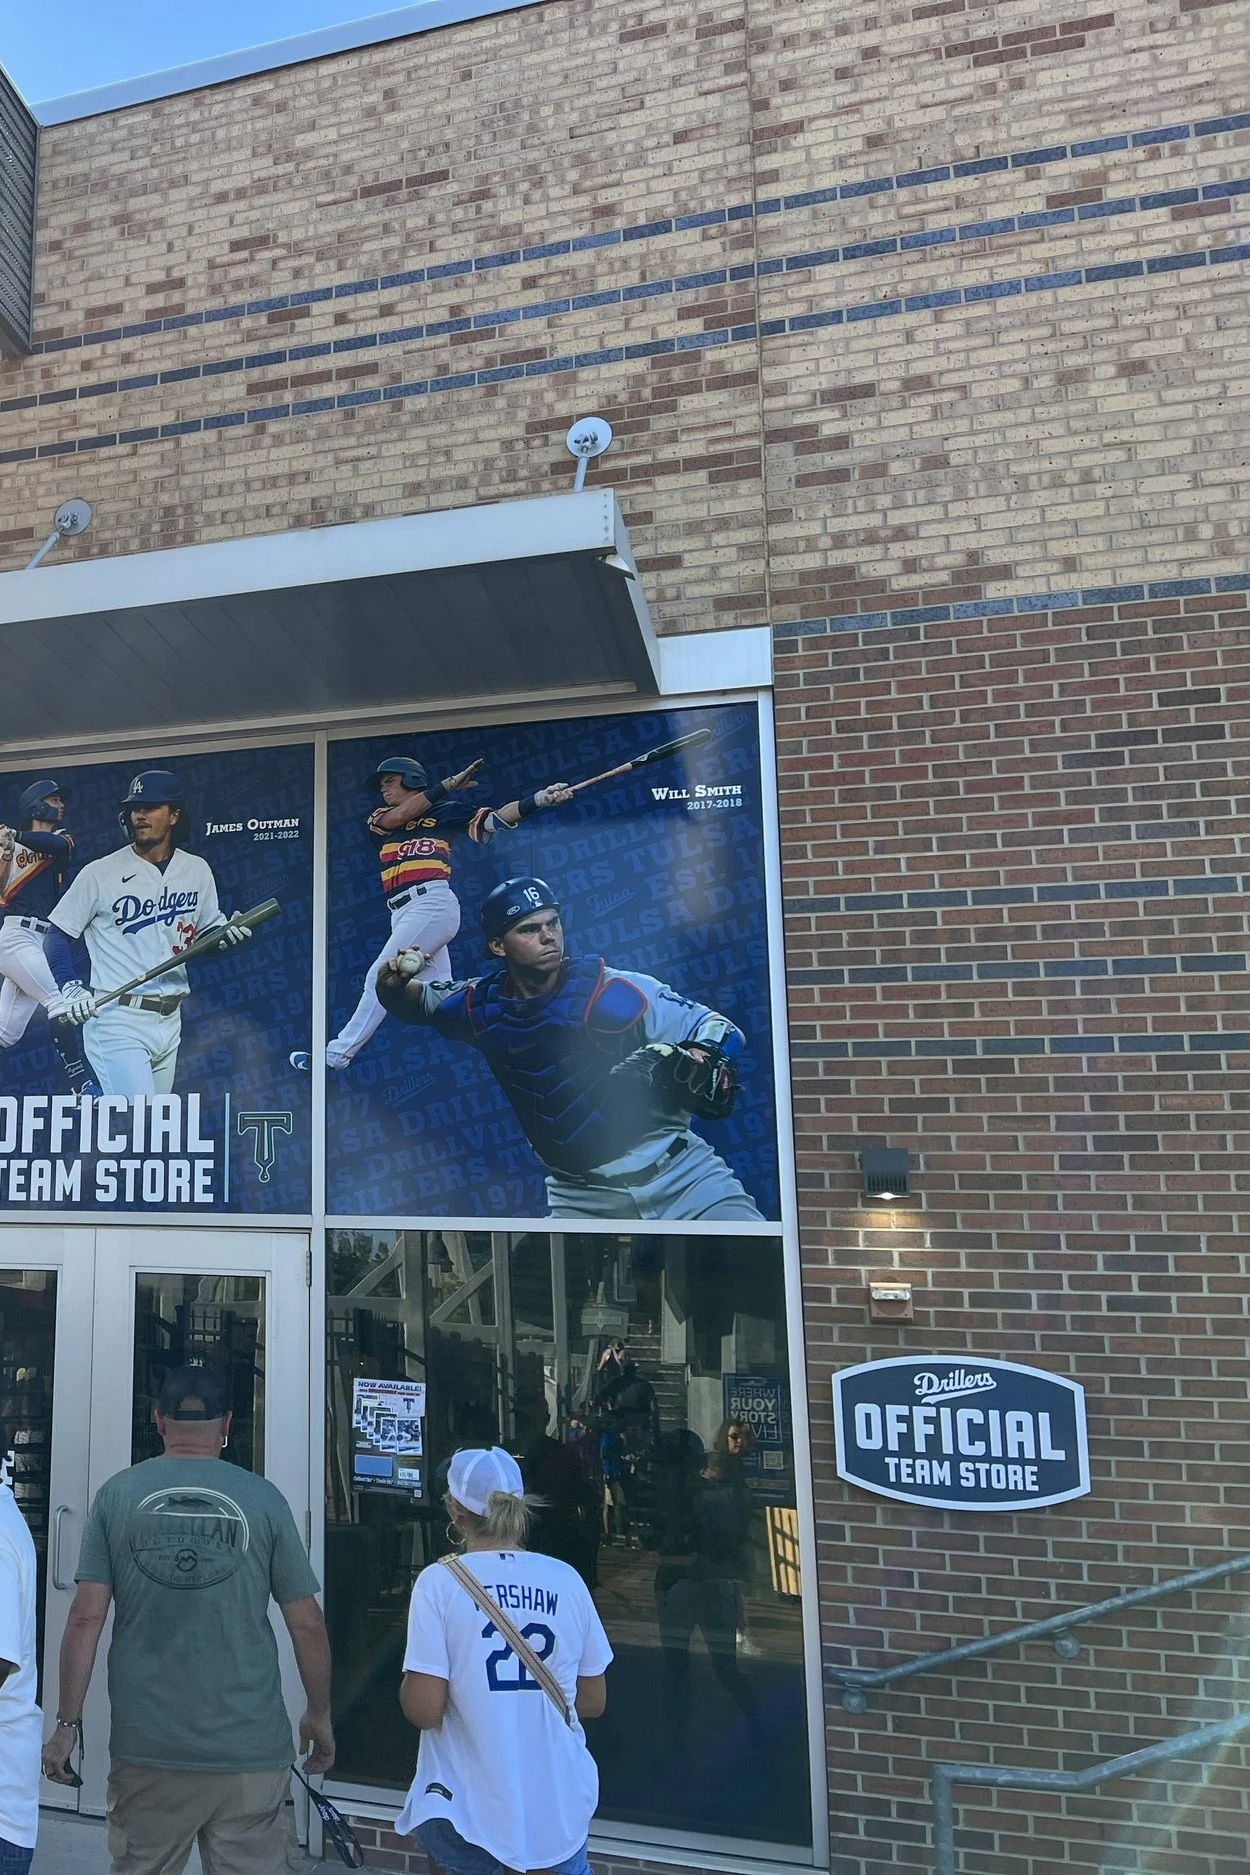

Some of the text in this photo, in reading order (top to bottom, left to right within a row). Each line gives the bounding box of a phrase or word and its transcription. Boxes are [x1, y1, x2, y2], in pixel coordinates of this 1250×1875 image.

[686, 797, 743, 811] 2017-2018
[253, 830, 300, 841] 2021-2022
[112, 886, 199, 935] Dodgers
[522, 886, 541, 903] 16
[95, 1158, 215, 1203] STORE
[913, 1368, 997, 1405] Drillers
[854, 1402, 1066, 1461] OFFICIAL
[884, 1457, 1040, 1492] TEAM STORE
[482, 1622, 556, 1692] 22
